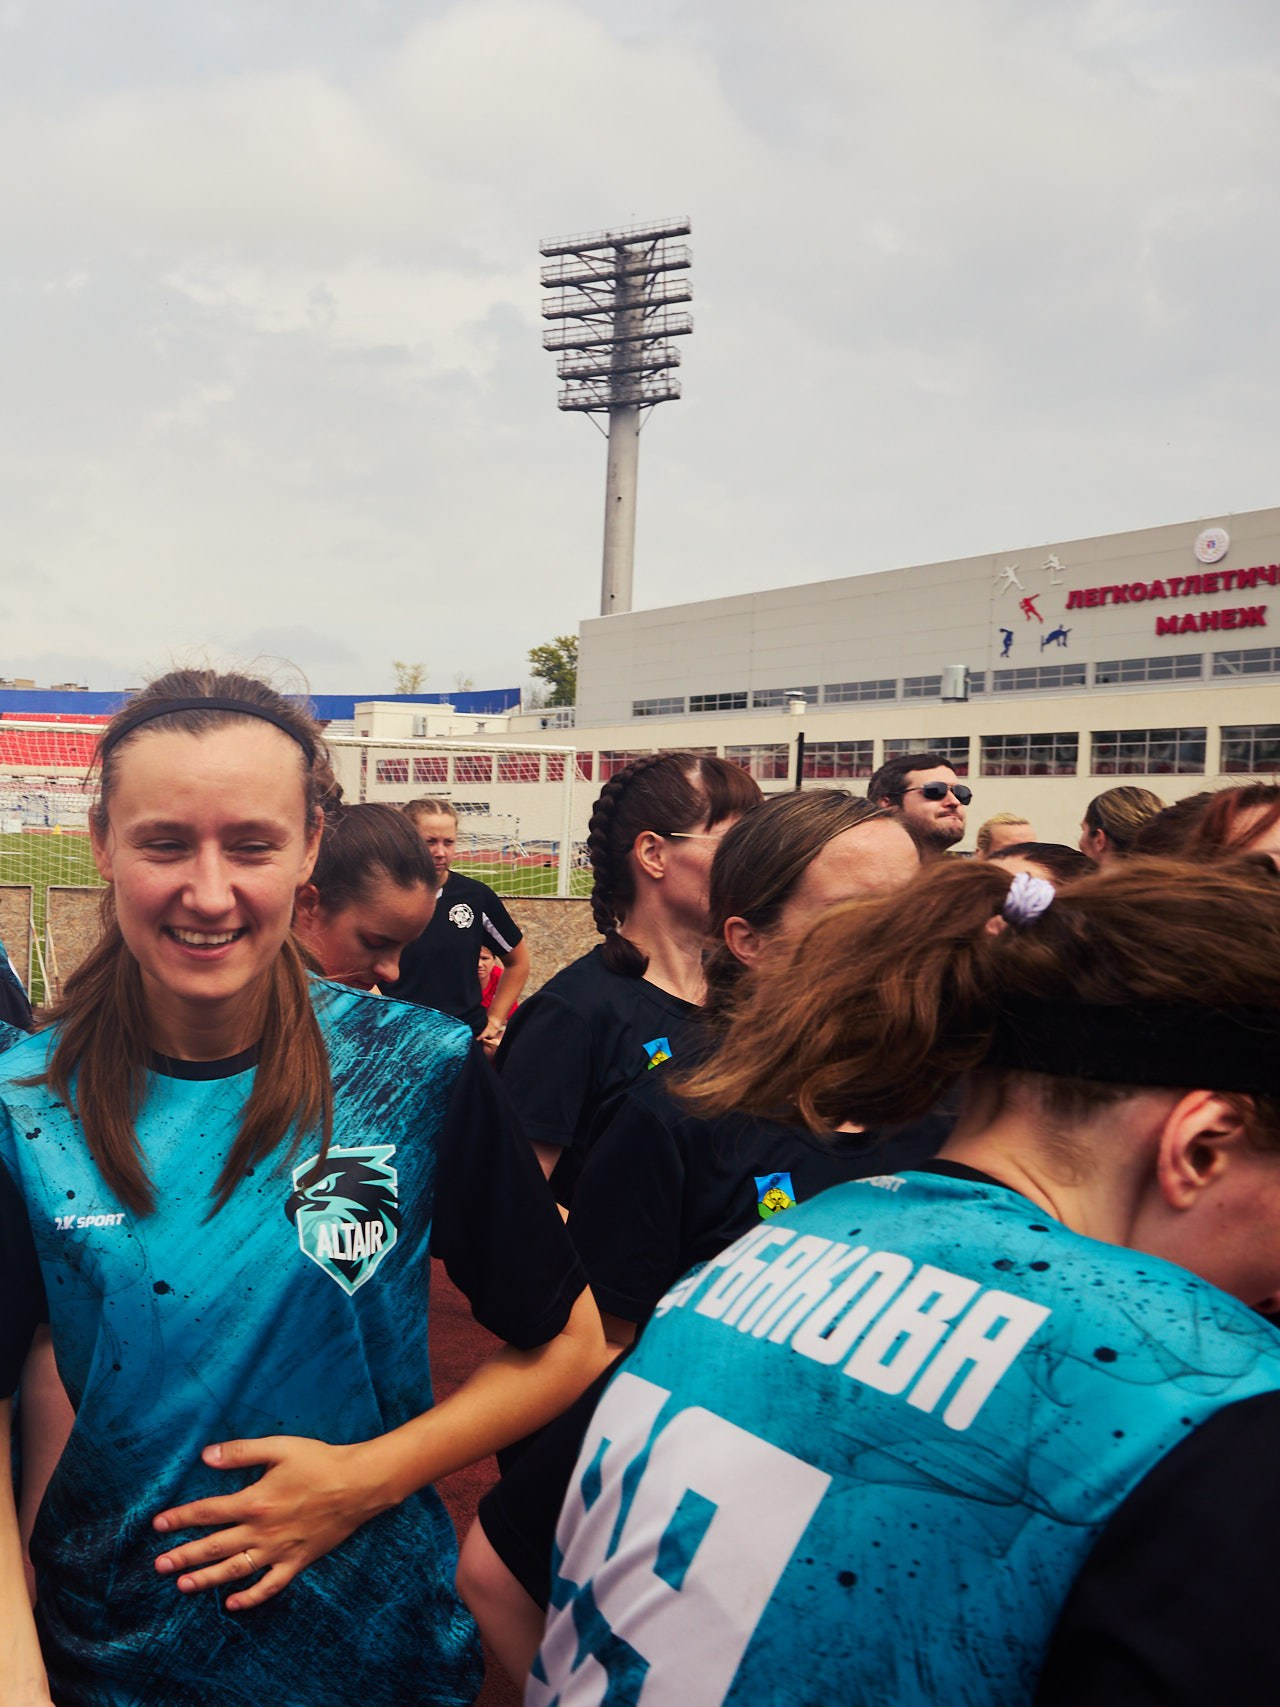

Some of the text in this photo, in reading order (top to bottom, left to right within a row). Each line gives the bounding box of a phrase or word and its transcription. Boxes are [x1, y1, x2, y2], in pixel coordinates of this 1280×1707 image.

[1065, 563, 1280, 609] ЛЕГКОАТЛЕТИЧ
[1155, 605, 1267, 636] МАНЕЖ
[77, 1213, 126, 1229] SPORT
[315, 1220, 384, 1262] ALTAIR
[655, 1223, 1052, 1432] РБАКОВА
